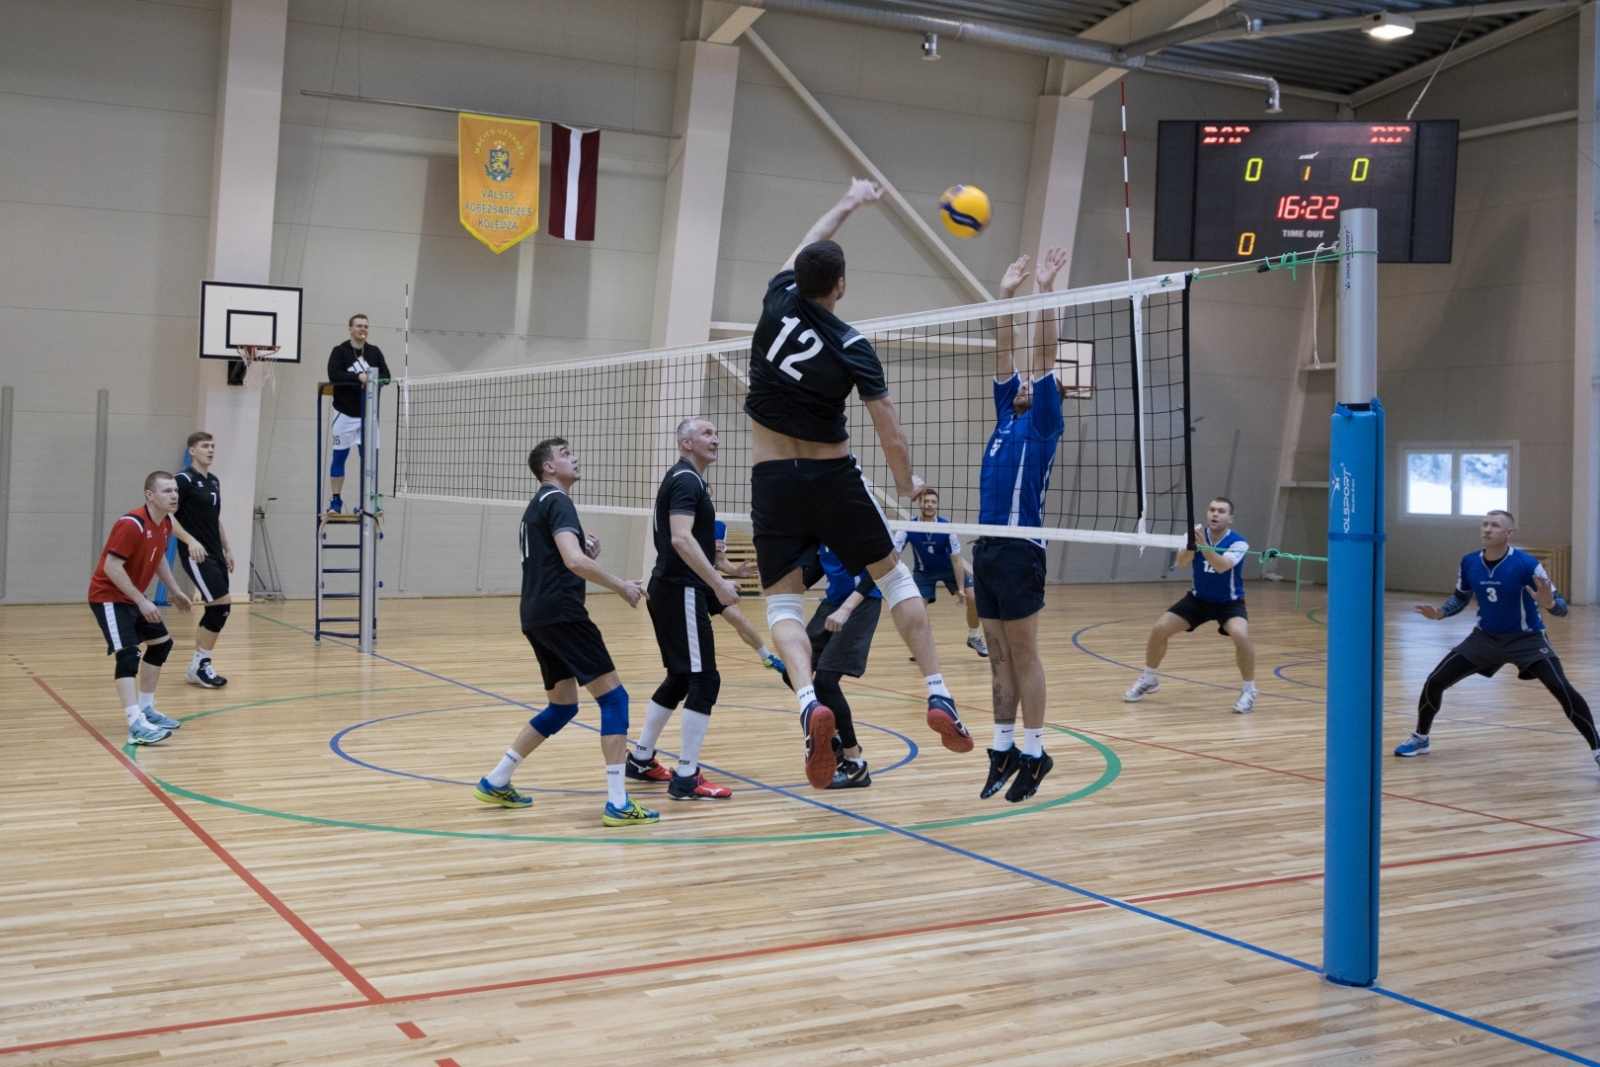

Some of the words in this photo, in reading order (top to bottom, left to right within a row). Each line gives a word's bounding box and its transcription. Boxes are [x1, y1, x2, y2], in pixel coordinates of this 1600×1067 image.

[1245, 157, 1263, 182] 0
[1351, 157, 1370, 182] 0
[481, 189, 515, 201] VALSTS
[465, 200, 533, 217] ROBEŽSARDZES
[1276, 195, 1341, 220] 16:22
[478, 217, 519, 230] KOLEDŽA
[1237, 232, 1256, 256] 0
[1282, 229, 1305, 238] TIME
[1306, 229, 1325, 239] OUT
[765, 315, 825, 382] 12
[210, 492, 217, 506] 7
[1343, 466, 1352, 543] OLSPORT
[1486, 587, 1498, 603] 3
